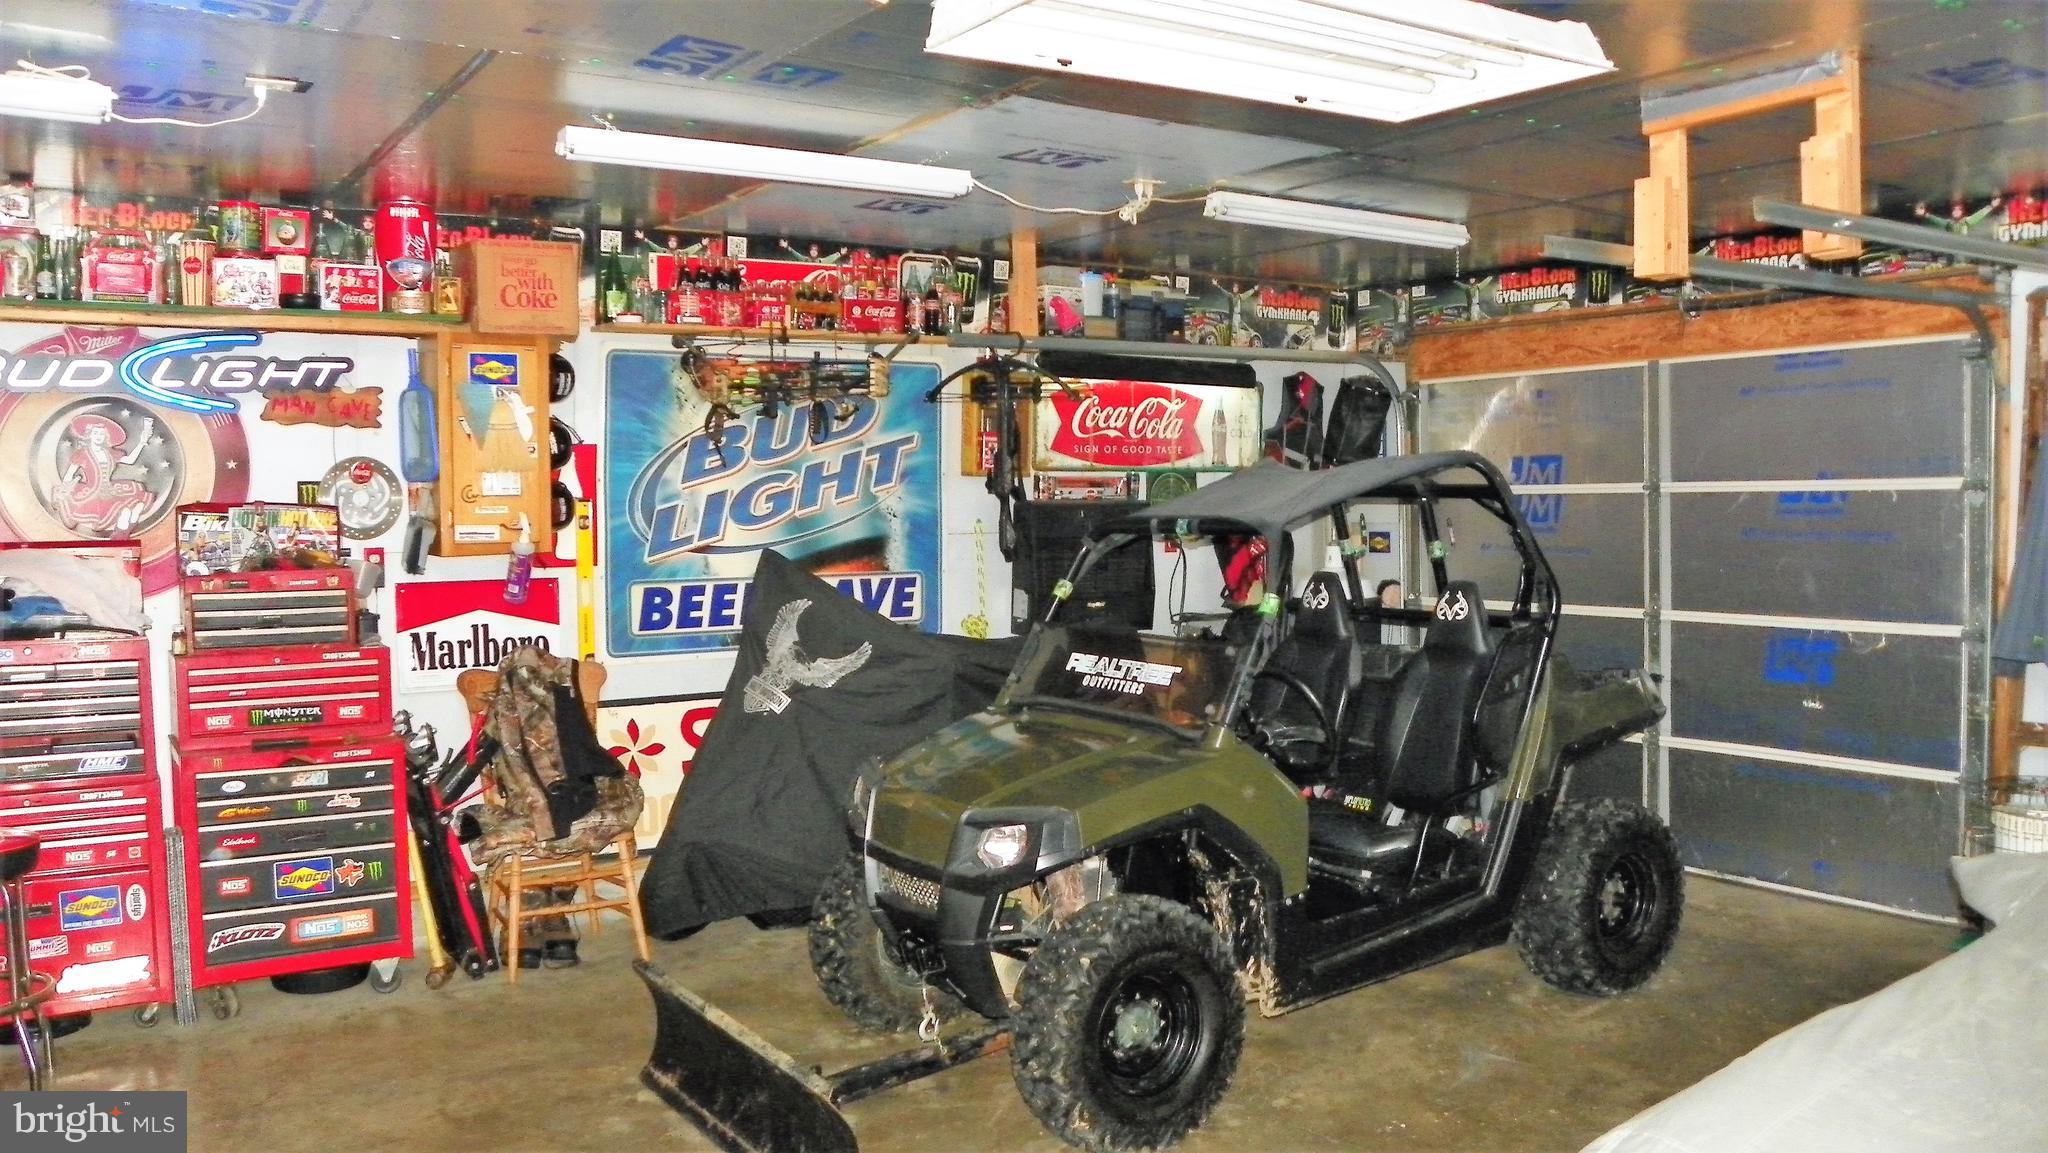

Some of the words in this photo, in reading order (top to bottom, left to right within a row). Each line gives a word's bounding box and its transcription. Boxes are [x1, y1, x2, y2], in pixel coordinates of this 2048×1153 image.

[501, 265, 537, 278] better
[517, 272, 555, 290] with
[500, 284, 558, 309] Coke
[79, 335, 124, 350] Miller
[0, 358, 114, 388] UD
[151, 357, 349, 388] LIGHT
[271, 395, 316, 416] MAN
[328, 395, 372, 421] CAVE
[1071, 395, 1187, 439] Coca-Cola
[682, 397, 880, 489] BUD
[1074, 443, 1099, 454] SIGN
[1104, 444, 1118, 454] OF
[1122, 445, 1152, 454] GOOD
[1156, 445, 1183, 455] TASTE
[645, 432, 920, 564] LIGHT
[638, 583, 753, 632] BEE
[835, 577, 917, 618] AVE
[322, 651, 361, 661] CRAFTSMAN
[1082, 674, 1146, 696] OUTFITTERS
[264, 706, 322, 717] MONSTER
[339, 705, 364, 716] NOS
[207, 714, 233, 727] NOS
[333, 749, 372, 758] CRAFTSMAN
[65, 850, 93, 862] NOS
[222, 878, 249, 891] NOS
[281, 871, 331, 885] SUNOCO
[67, 899, 115, 912] SUNOCO
[305, 919, 339, 934] NOS
[346, 919, 369, 930] NOS
[216, 927, 281, 948] KLOTZ
[30, 943, 55, 952] UMMIT
[86, 941, 113, 953] NOS
